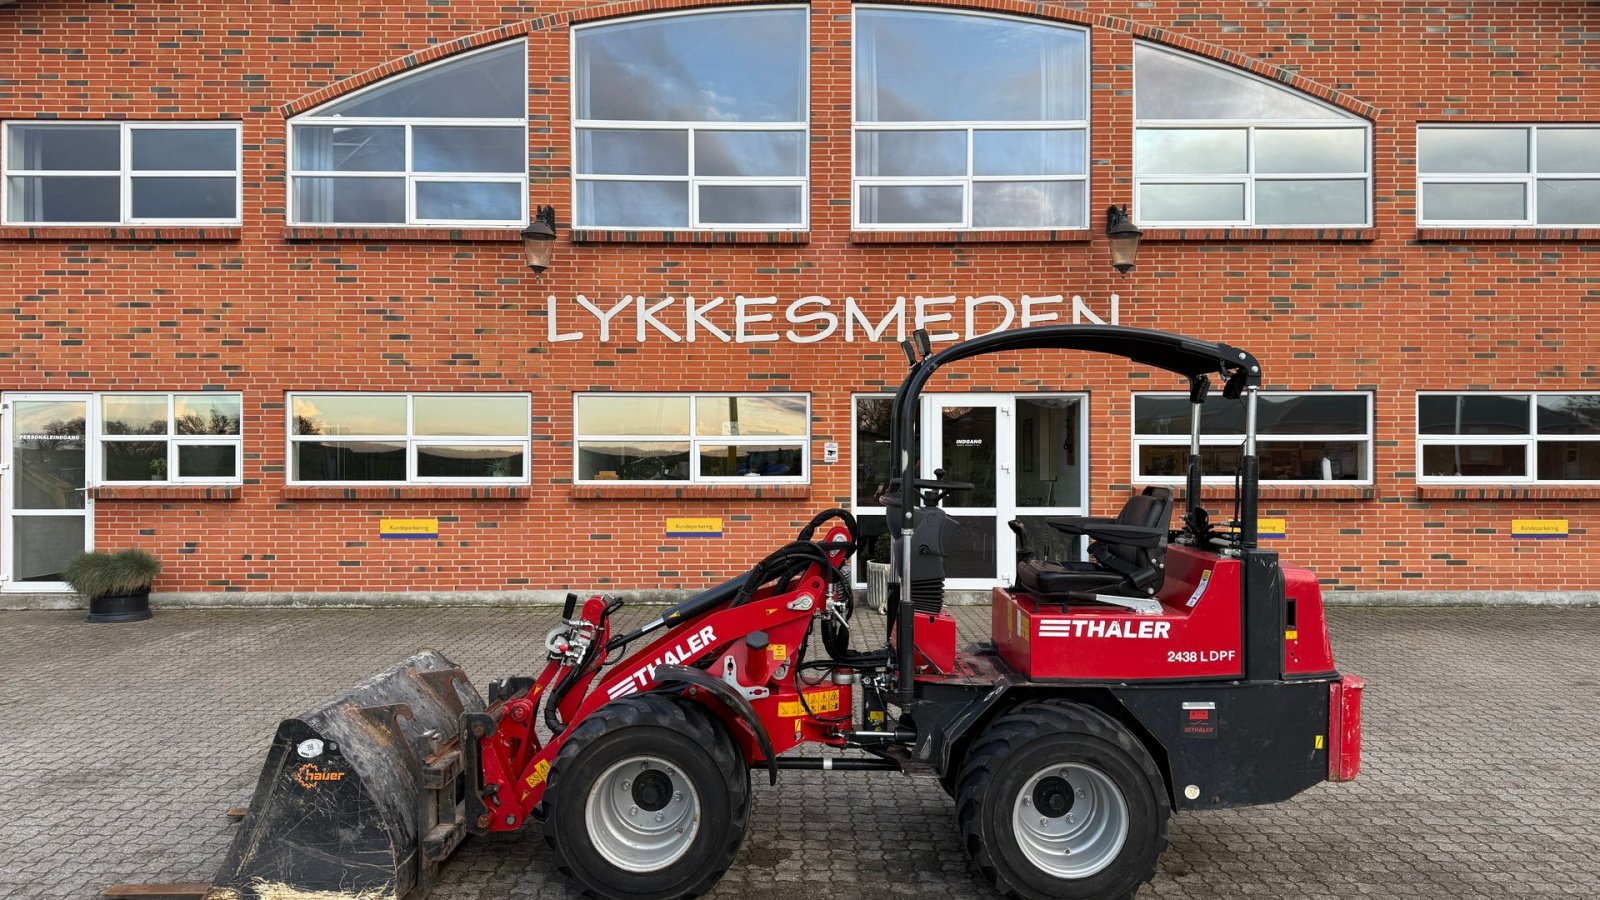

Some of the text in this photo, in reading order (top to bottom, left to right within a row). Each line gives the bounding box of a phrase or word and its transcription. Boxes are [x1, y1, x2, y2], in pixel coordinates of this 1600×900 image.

[547, 294, 1119, 343] LYKKESMEDEN
[1167, 650, 1236, 662] 2438 L DPF
